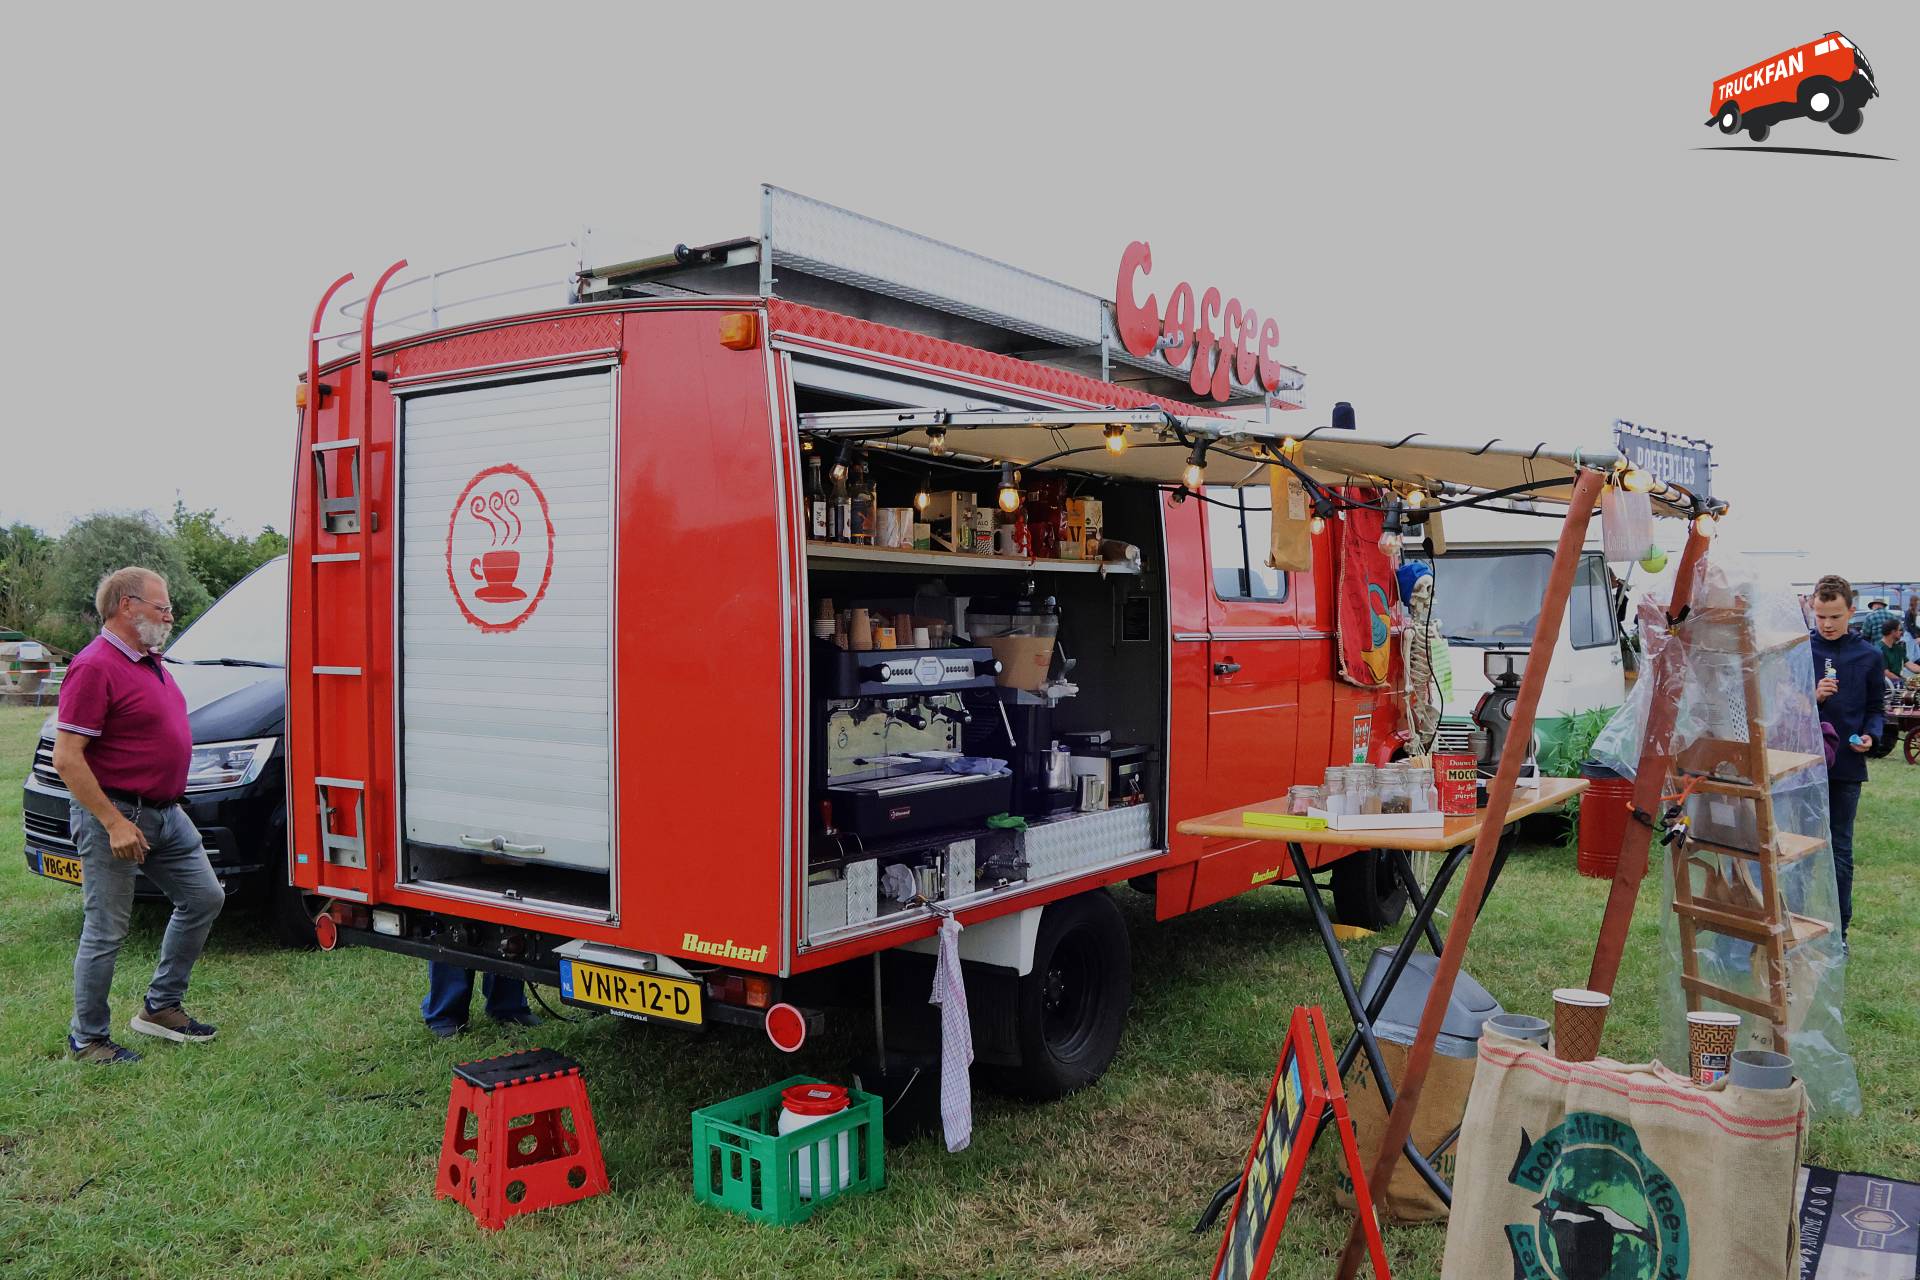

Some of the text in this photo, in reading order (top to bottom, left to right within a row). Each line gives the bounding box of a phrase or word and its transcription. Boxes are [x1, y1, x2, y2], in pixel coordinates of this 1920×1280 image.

[1116, 241, 1281, 402] Coffee
[1448, 770, 1477, 780] MOCC
[44, 857, 82, 879] VBG-45-
[682, 933, 768, 963] Bachert
[563, 982, 573, 992] NL
[580, 970, 690, 1015] VNR-12-D
